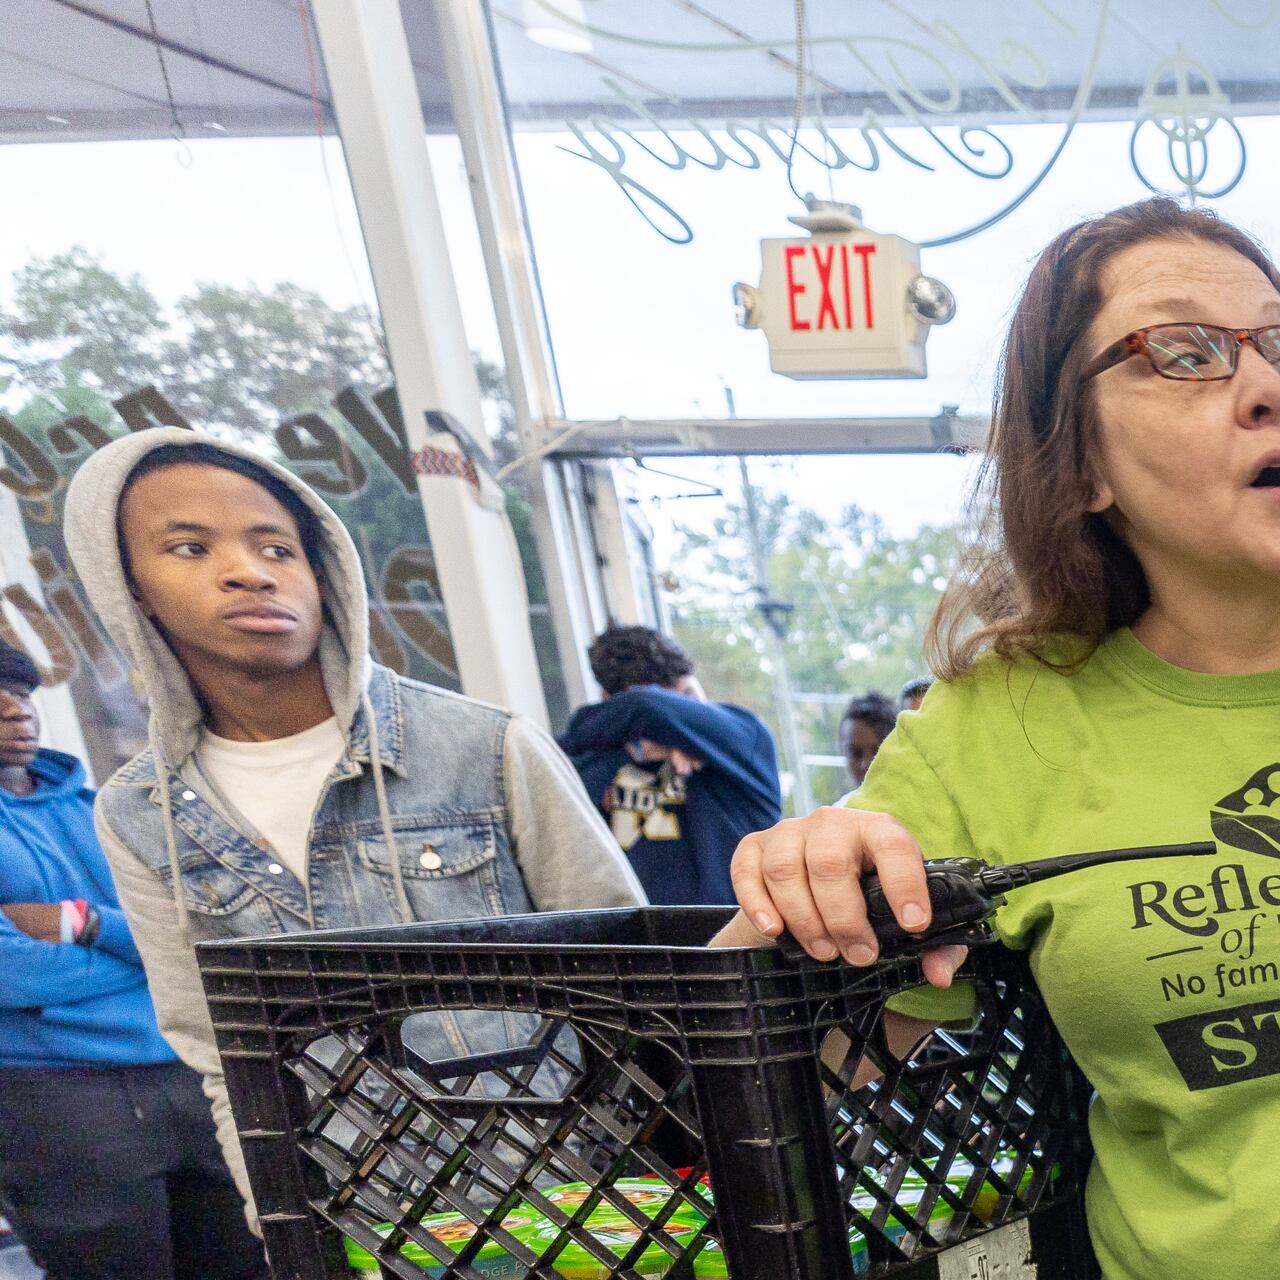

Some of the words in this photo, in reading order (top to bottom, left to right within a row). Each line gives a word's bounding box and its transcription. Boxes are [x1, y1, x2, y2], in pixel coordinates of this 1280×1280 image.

[784, 243, 877, 332] EXIT
[1220, 913, 1266, 960] of
[1160, 974, 1206, 1002] No
